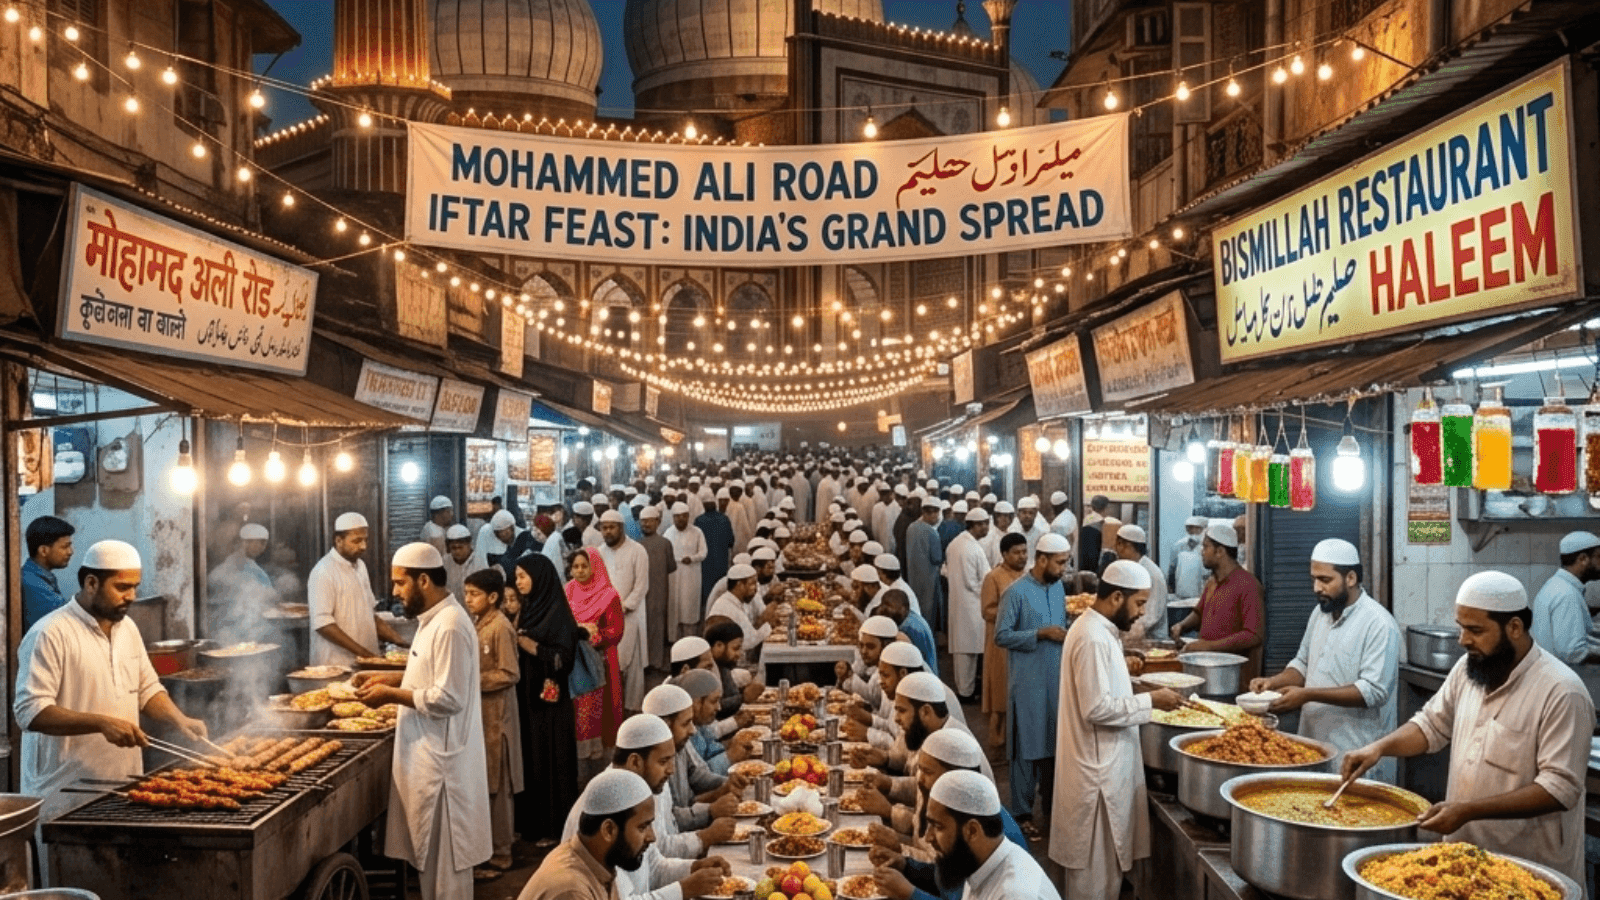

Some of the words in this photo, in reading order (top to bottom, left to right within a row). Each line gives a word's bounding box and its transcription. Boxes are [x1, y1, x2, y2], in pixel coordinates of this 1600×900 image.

[429, 193, 530, 241] IFTAR
[544, 205, 670, 250] FEAST:
[684, 211, 808, 252] INDIA'S
[821, 207, 946, 251] GRAND
[960, 189, 1104, 241] SPREAD
[452, 142, 679, 200] MOHAMMED
[693, 161, 755, 201] ALI
[773, 160, 878, 201] ROAD
[1219, 195, 1330, 286] BISMILLAH
[1338, 92, 1554, 245] RESTAURANT
[85, 209, 188, 304] मोहामद
[190, 250, 238, 309] अली
[241, 258, 274, 319] रोड
[1369, 191, 1558, 316] HALEEM
